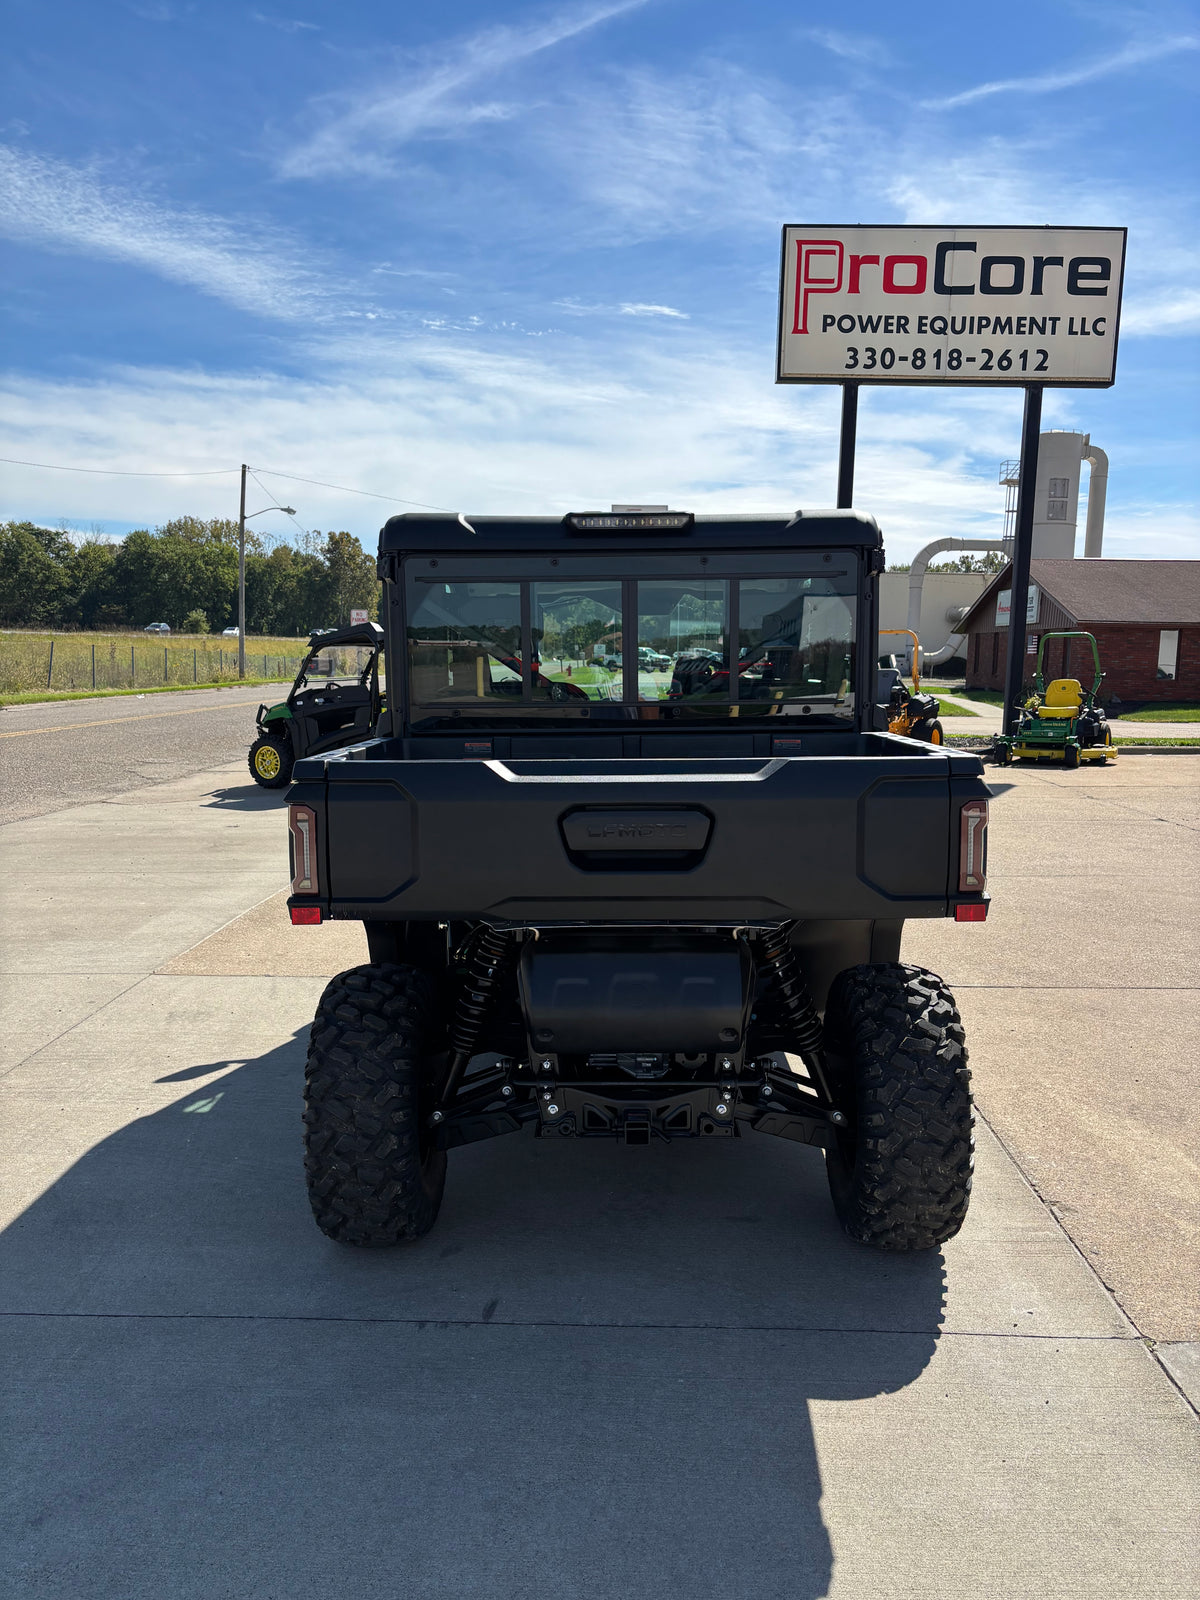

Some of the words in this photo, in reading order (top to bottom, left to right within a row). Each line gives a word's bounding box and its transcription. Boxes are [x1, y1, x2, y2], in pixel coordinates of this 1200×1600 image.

[792, 239, 1112, 335] ProCore
[821, 314, 910, 335] POWER
[917, 315, 1061, 336] EQUIPMENT
[1067, 316, 1107, 337] LLC
[844, 346, 1050, 372] 330-818-2612
